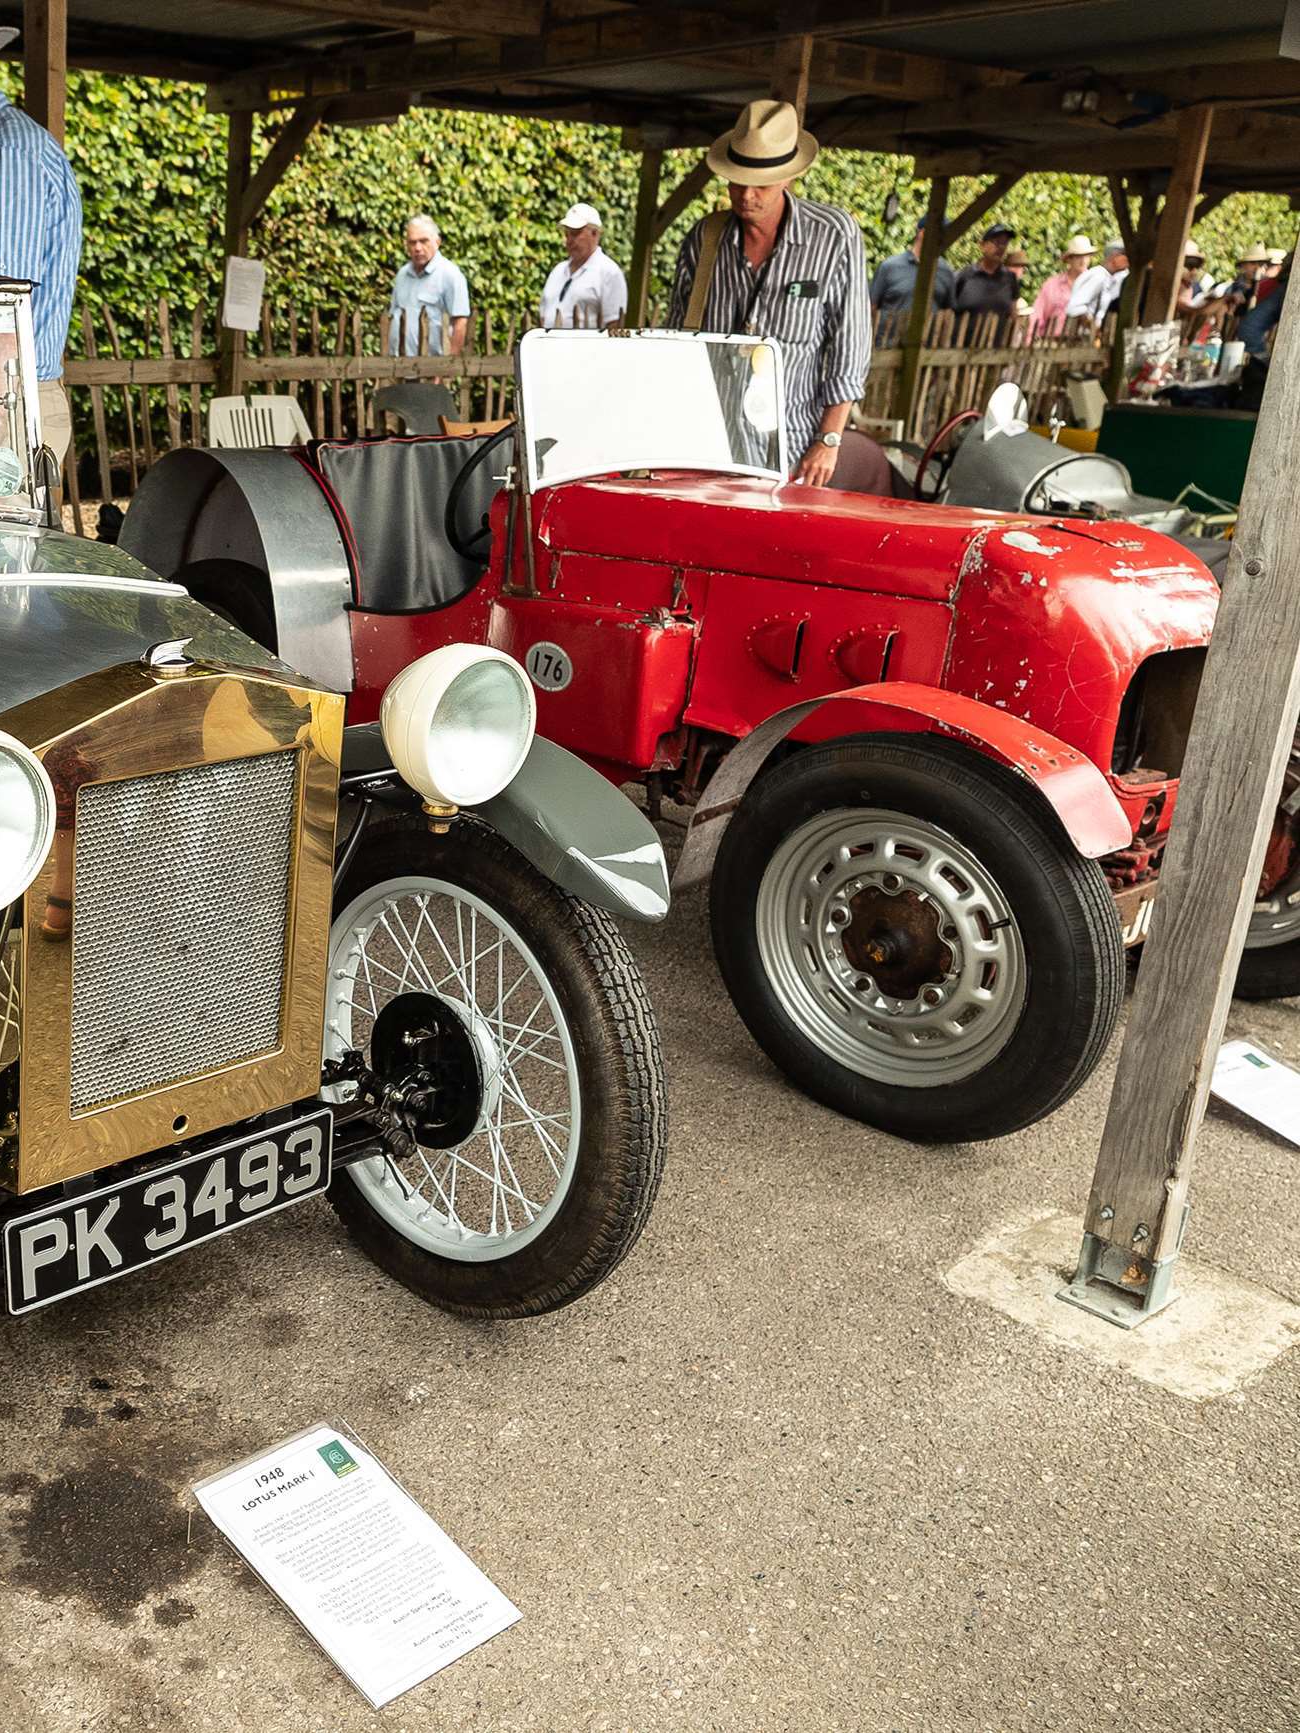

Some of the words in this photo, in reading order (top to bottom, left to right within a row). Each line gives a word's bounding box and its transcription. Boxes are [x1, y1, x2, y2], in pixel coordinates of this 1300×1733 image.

[533, 651, 563, 682] 176
[19, 1196, 122, 1300] PK
[143, 1125, 322, 1252] 3493
[242, 1489, 277, 1511] LOTUS
[277, 1473, 309, 1493] MARK
[254, 1467, 285, 1488] 1948
